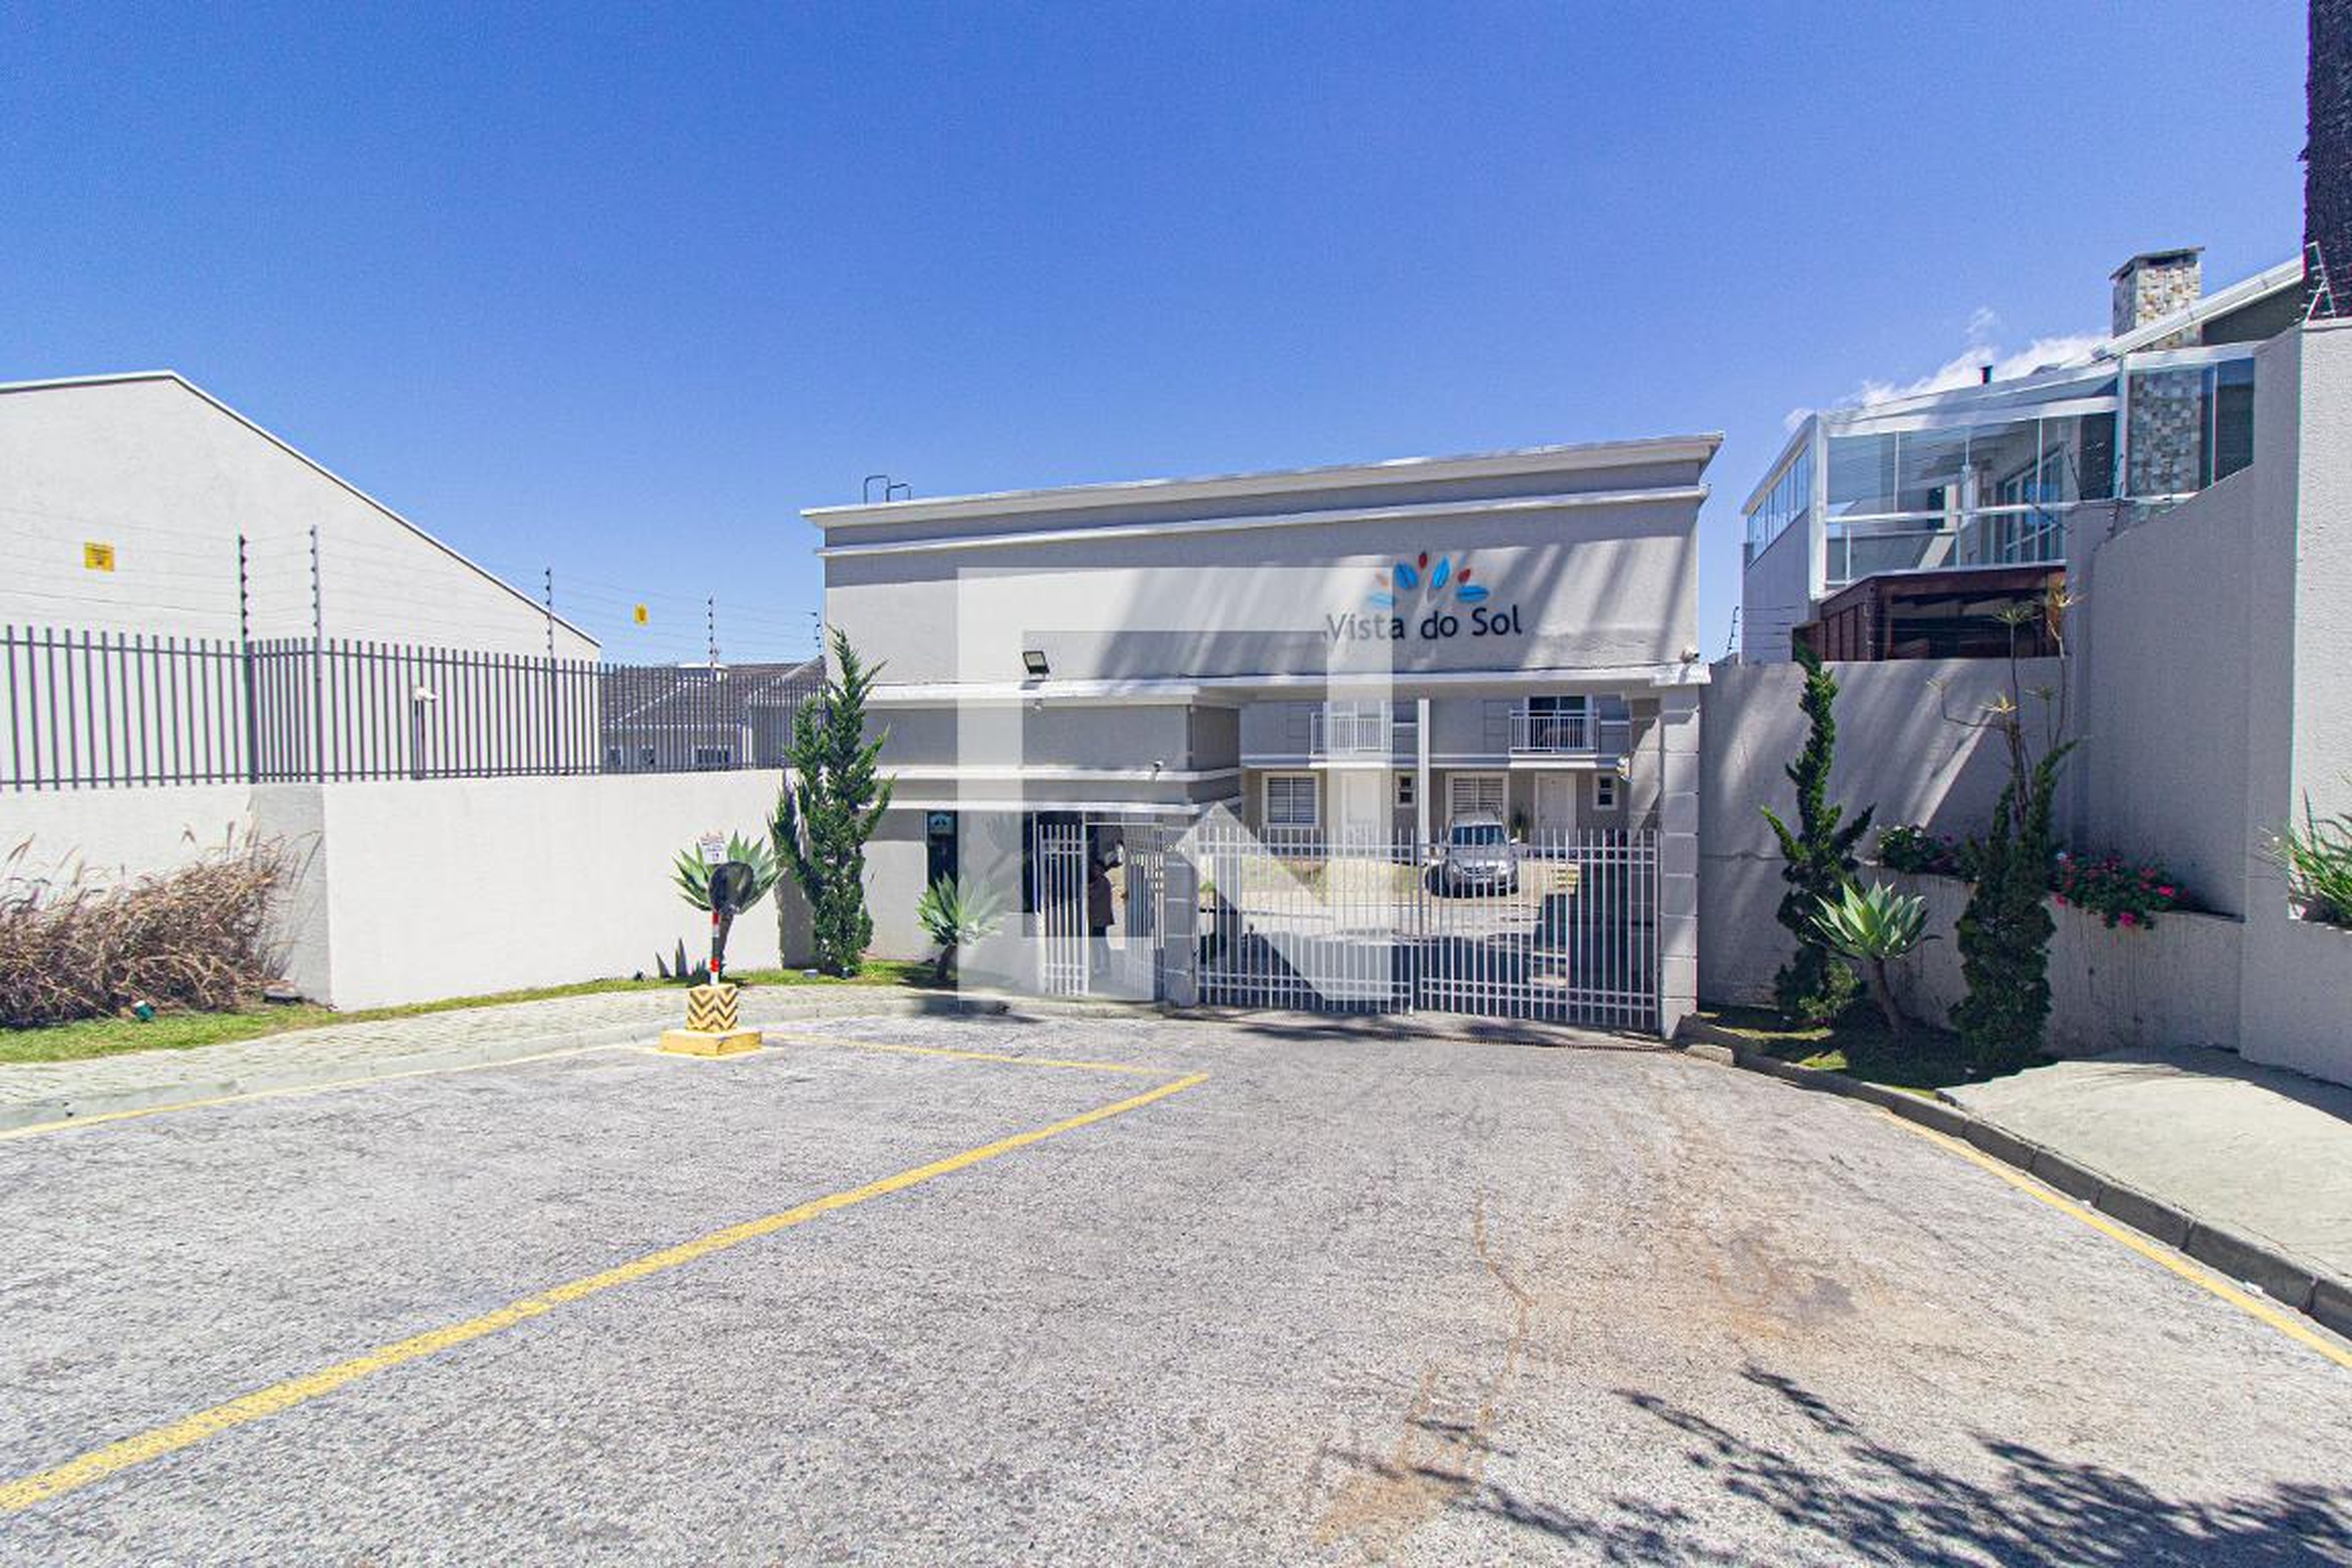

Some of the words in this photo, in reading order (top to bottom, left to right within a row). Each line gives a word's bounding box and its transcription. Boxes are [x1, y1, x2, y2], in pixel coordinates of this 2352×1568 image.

[1326, 613, 1406, 641] Vista
[1420, 610, 1458, 640] do
[1471, 604, 1523, 637] Sol
